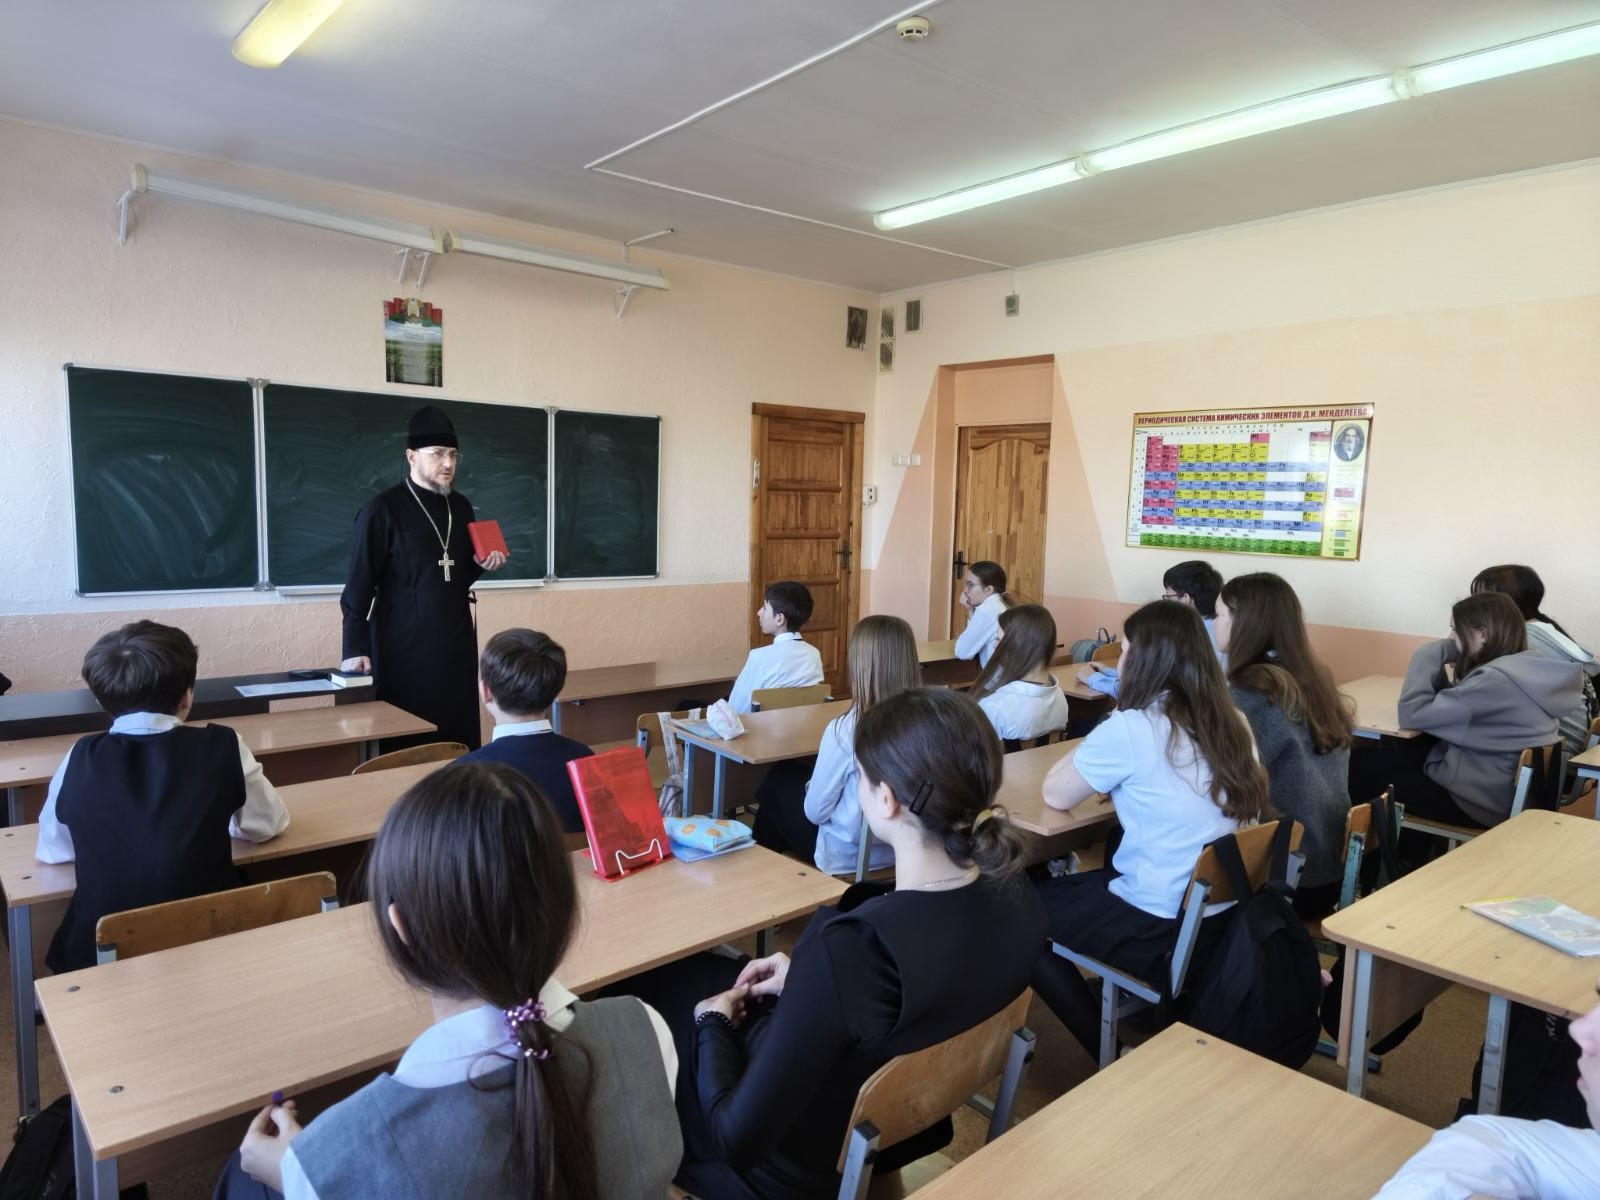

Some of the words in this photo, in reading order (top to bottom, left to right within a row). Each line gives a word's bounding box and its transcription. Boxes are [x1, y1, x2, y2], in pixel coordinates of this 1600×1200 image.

[1138, 415, 1187, 425] ПЕРИОДИЧЕСКАЯ
[1187, 414, 1216, 423] СИСТЕМА
[1216, 412, 1260, 421] ХИМИЧЕСКИХ
[1260, 410, 1302, 420] ЭЛЕМЕНТОВ
[1319, 408, 1367, 418] МЕНДЕЛЕЕВА
